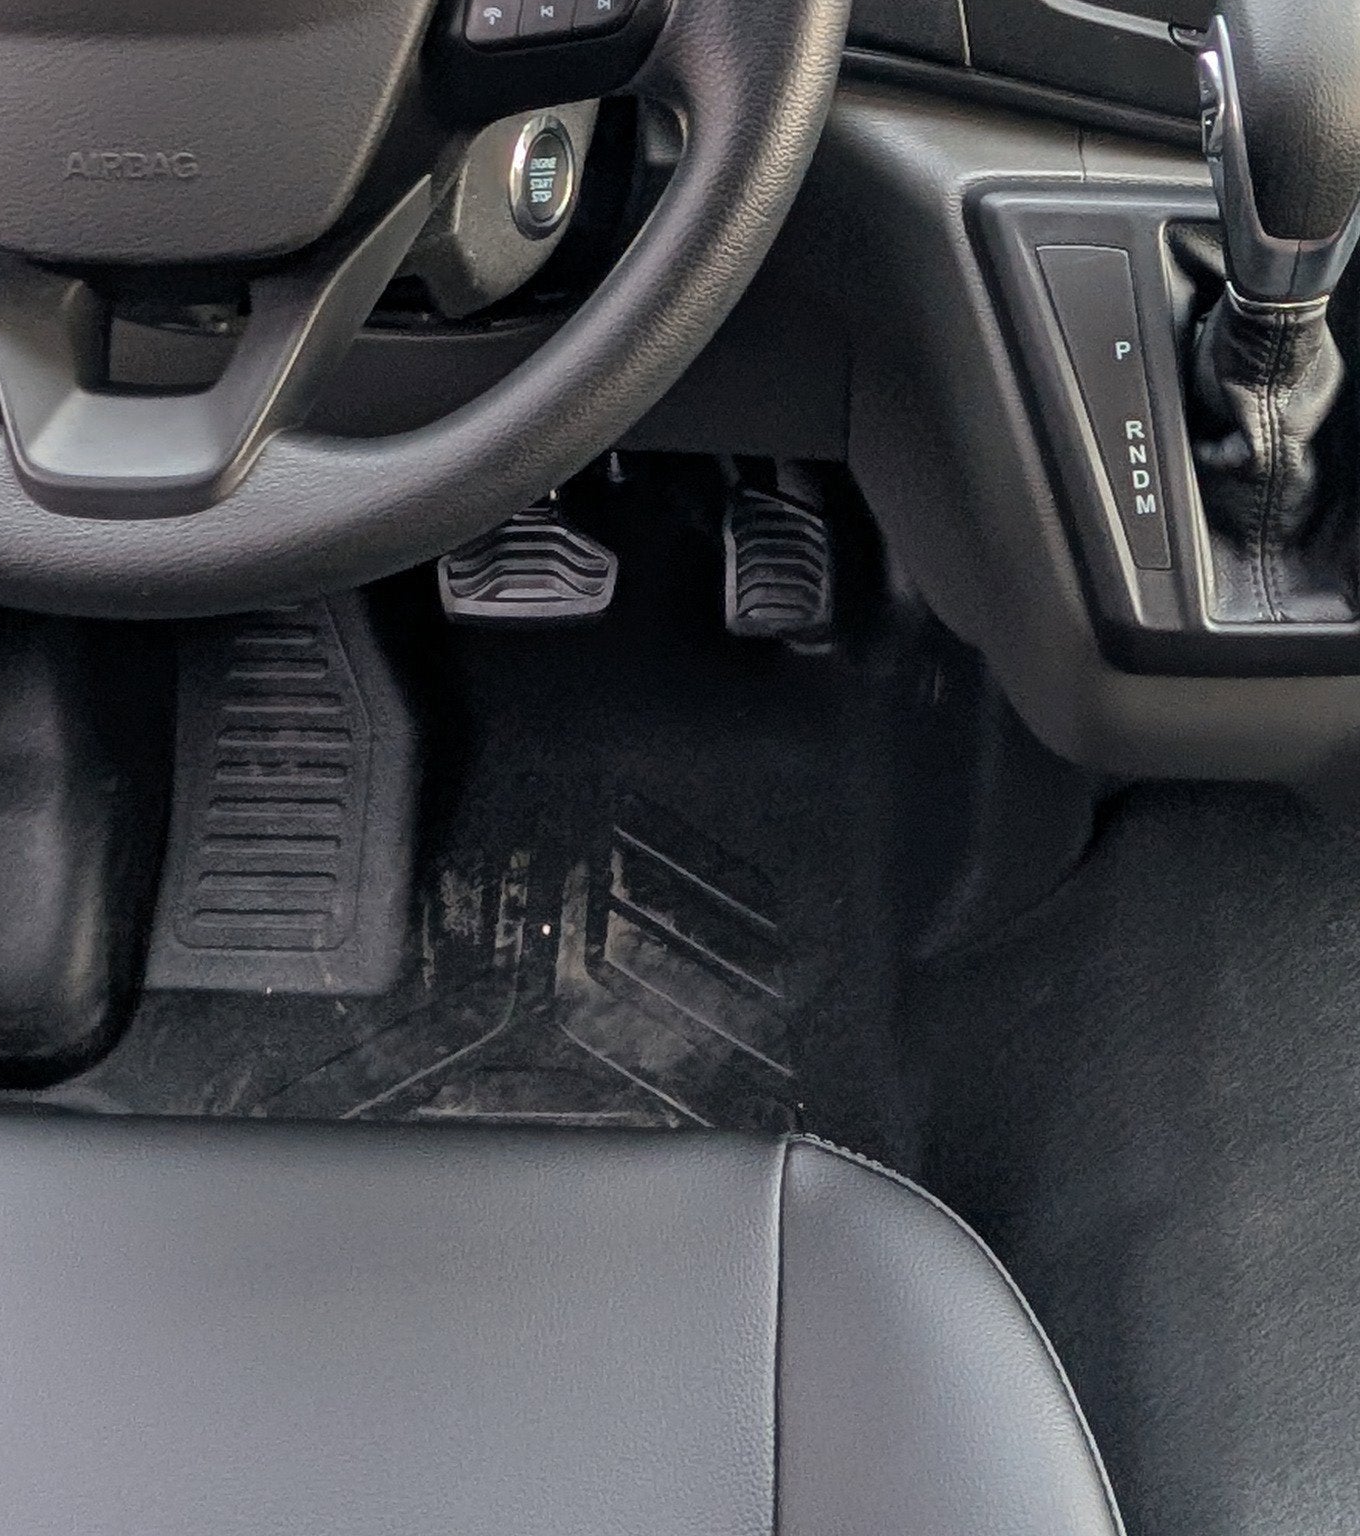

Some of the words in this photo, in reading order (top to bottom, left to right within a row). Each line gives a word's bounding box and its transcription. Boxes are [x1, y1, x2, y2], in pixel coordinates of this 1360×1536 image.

[63, 151, 199, 182] AIRBAG
[1115, 341, 1131, 360] P
[1125, 420, 1145, 440] R
[1129, 445, 1147, 464] N
[1132, 469, 1150, 489] D
[1136, 494, 1156, 514] M
